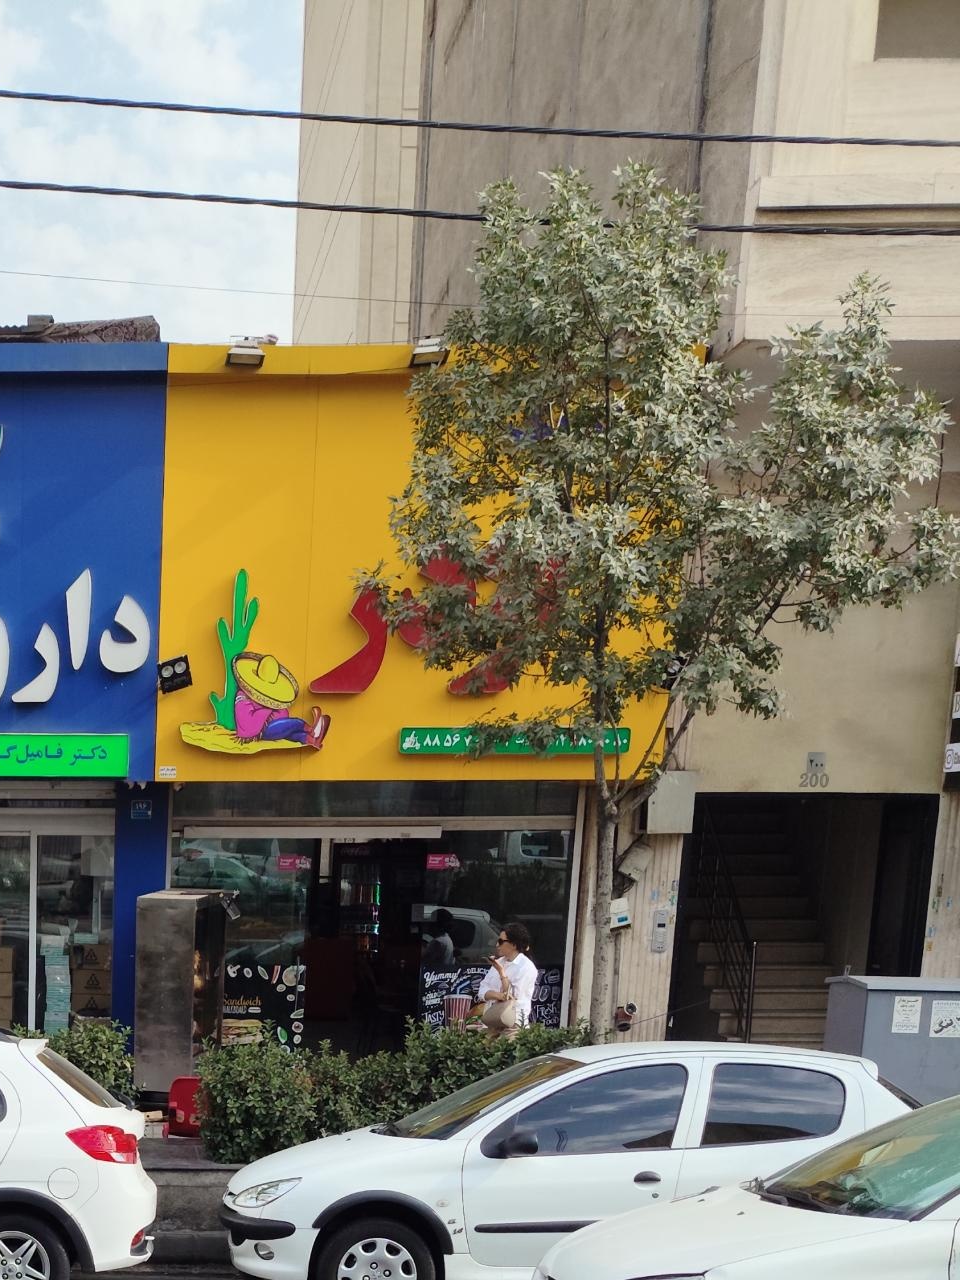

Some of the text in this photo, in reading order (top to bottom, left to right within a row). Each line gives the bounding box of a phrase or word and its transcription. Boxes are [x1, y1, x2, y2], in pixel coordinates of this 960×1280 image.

[16, 743, 63, 764] فامیل
[68, 745, 108, 766] دکتر
[798, 773, 830, 788] 200
